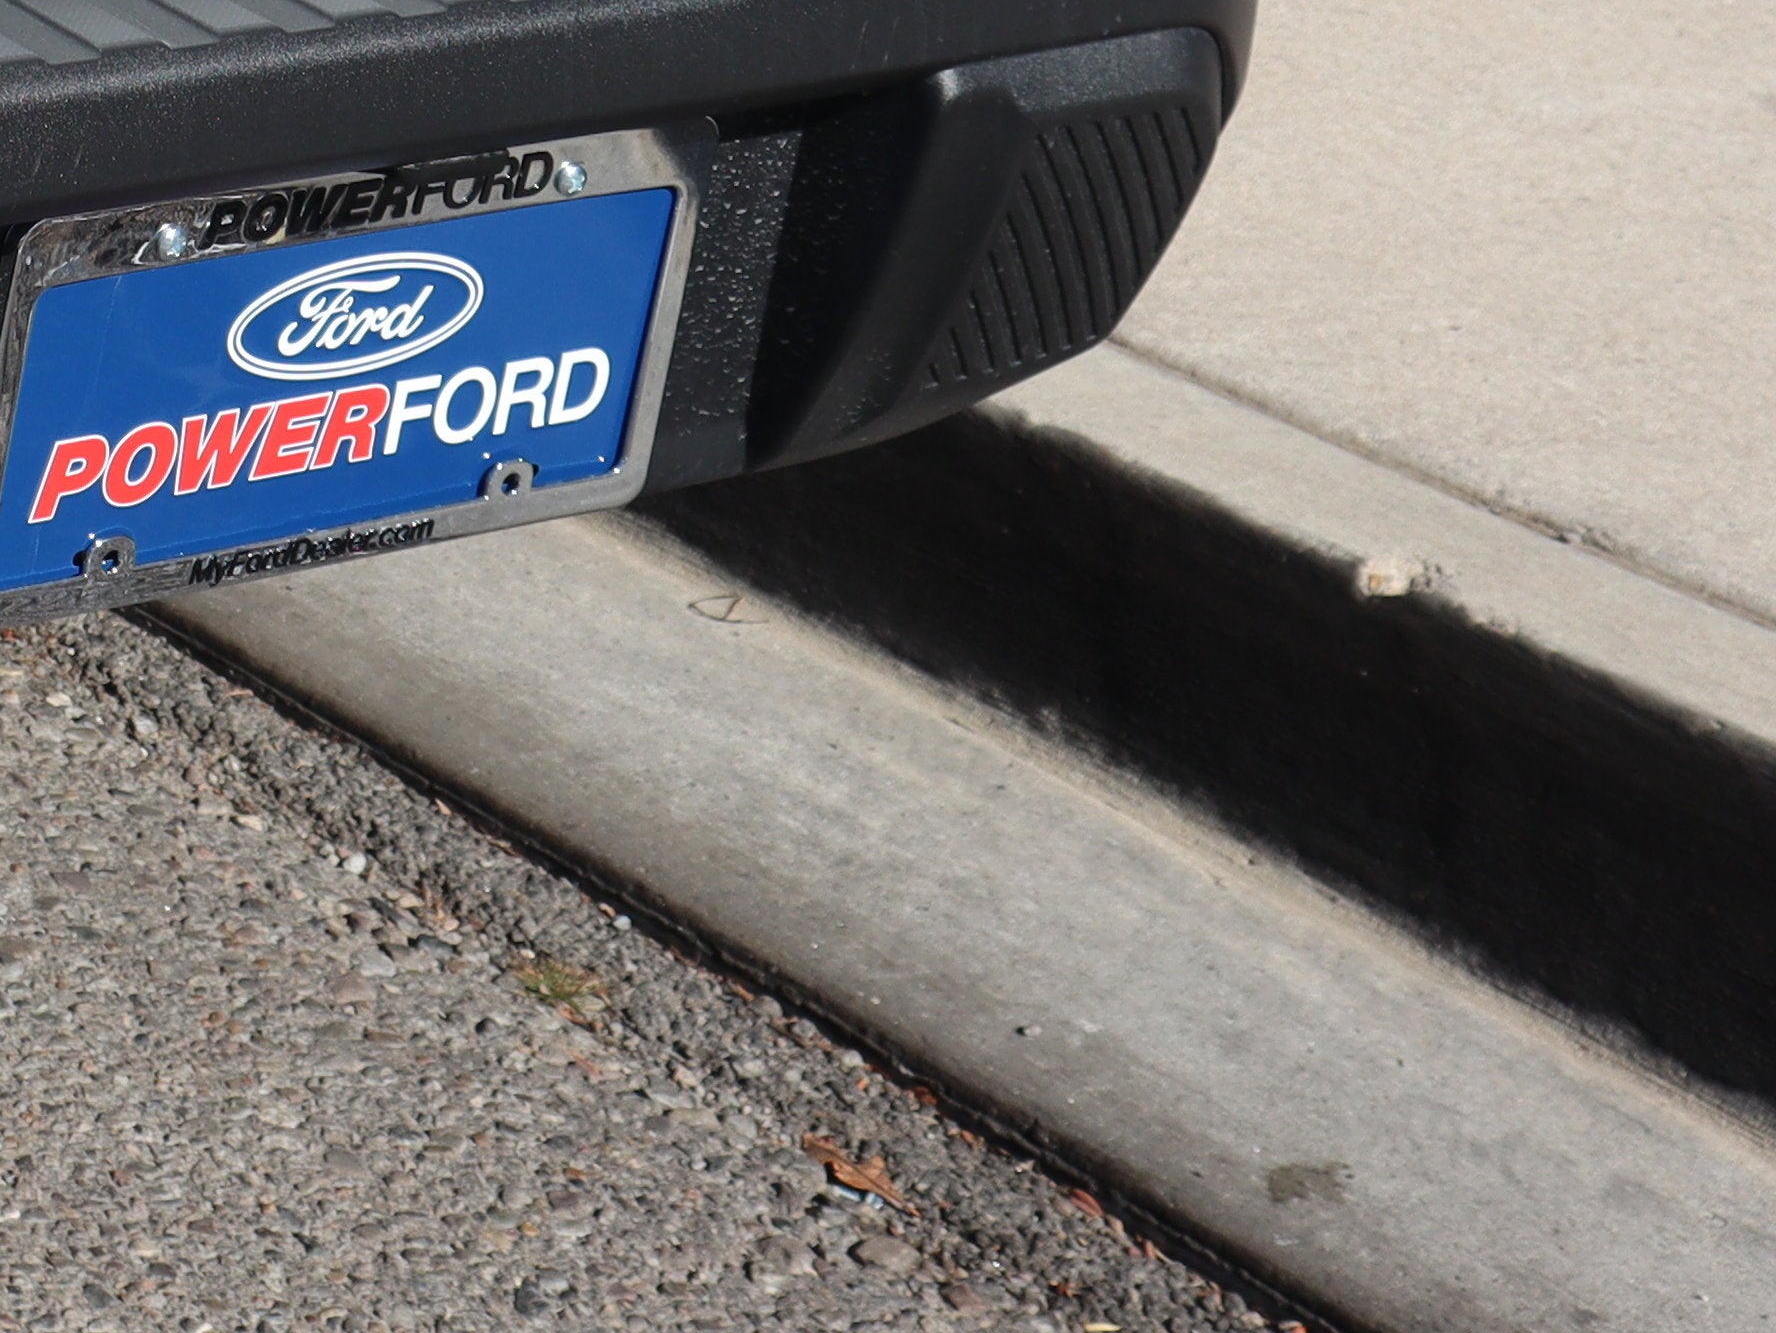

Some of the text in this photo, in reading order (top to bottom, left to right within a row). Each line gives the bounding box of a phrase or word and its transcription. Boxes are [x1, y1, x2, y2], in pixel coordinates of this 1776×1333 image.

[198, 149, 555, 253] POWERFORD
[276, 274, 435, 358] Ford
[27, 346, 611, 525] POWERFORD
